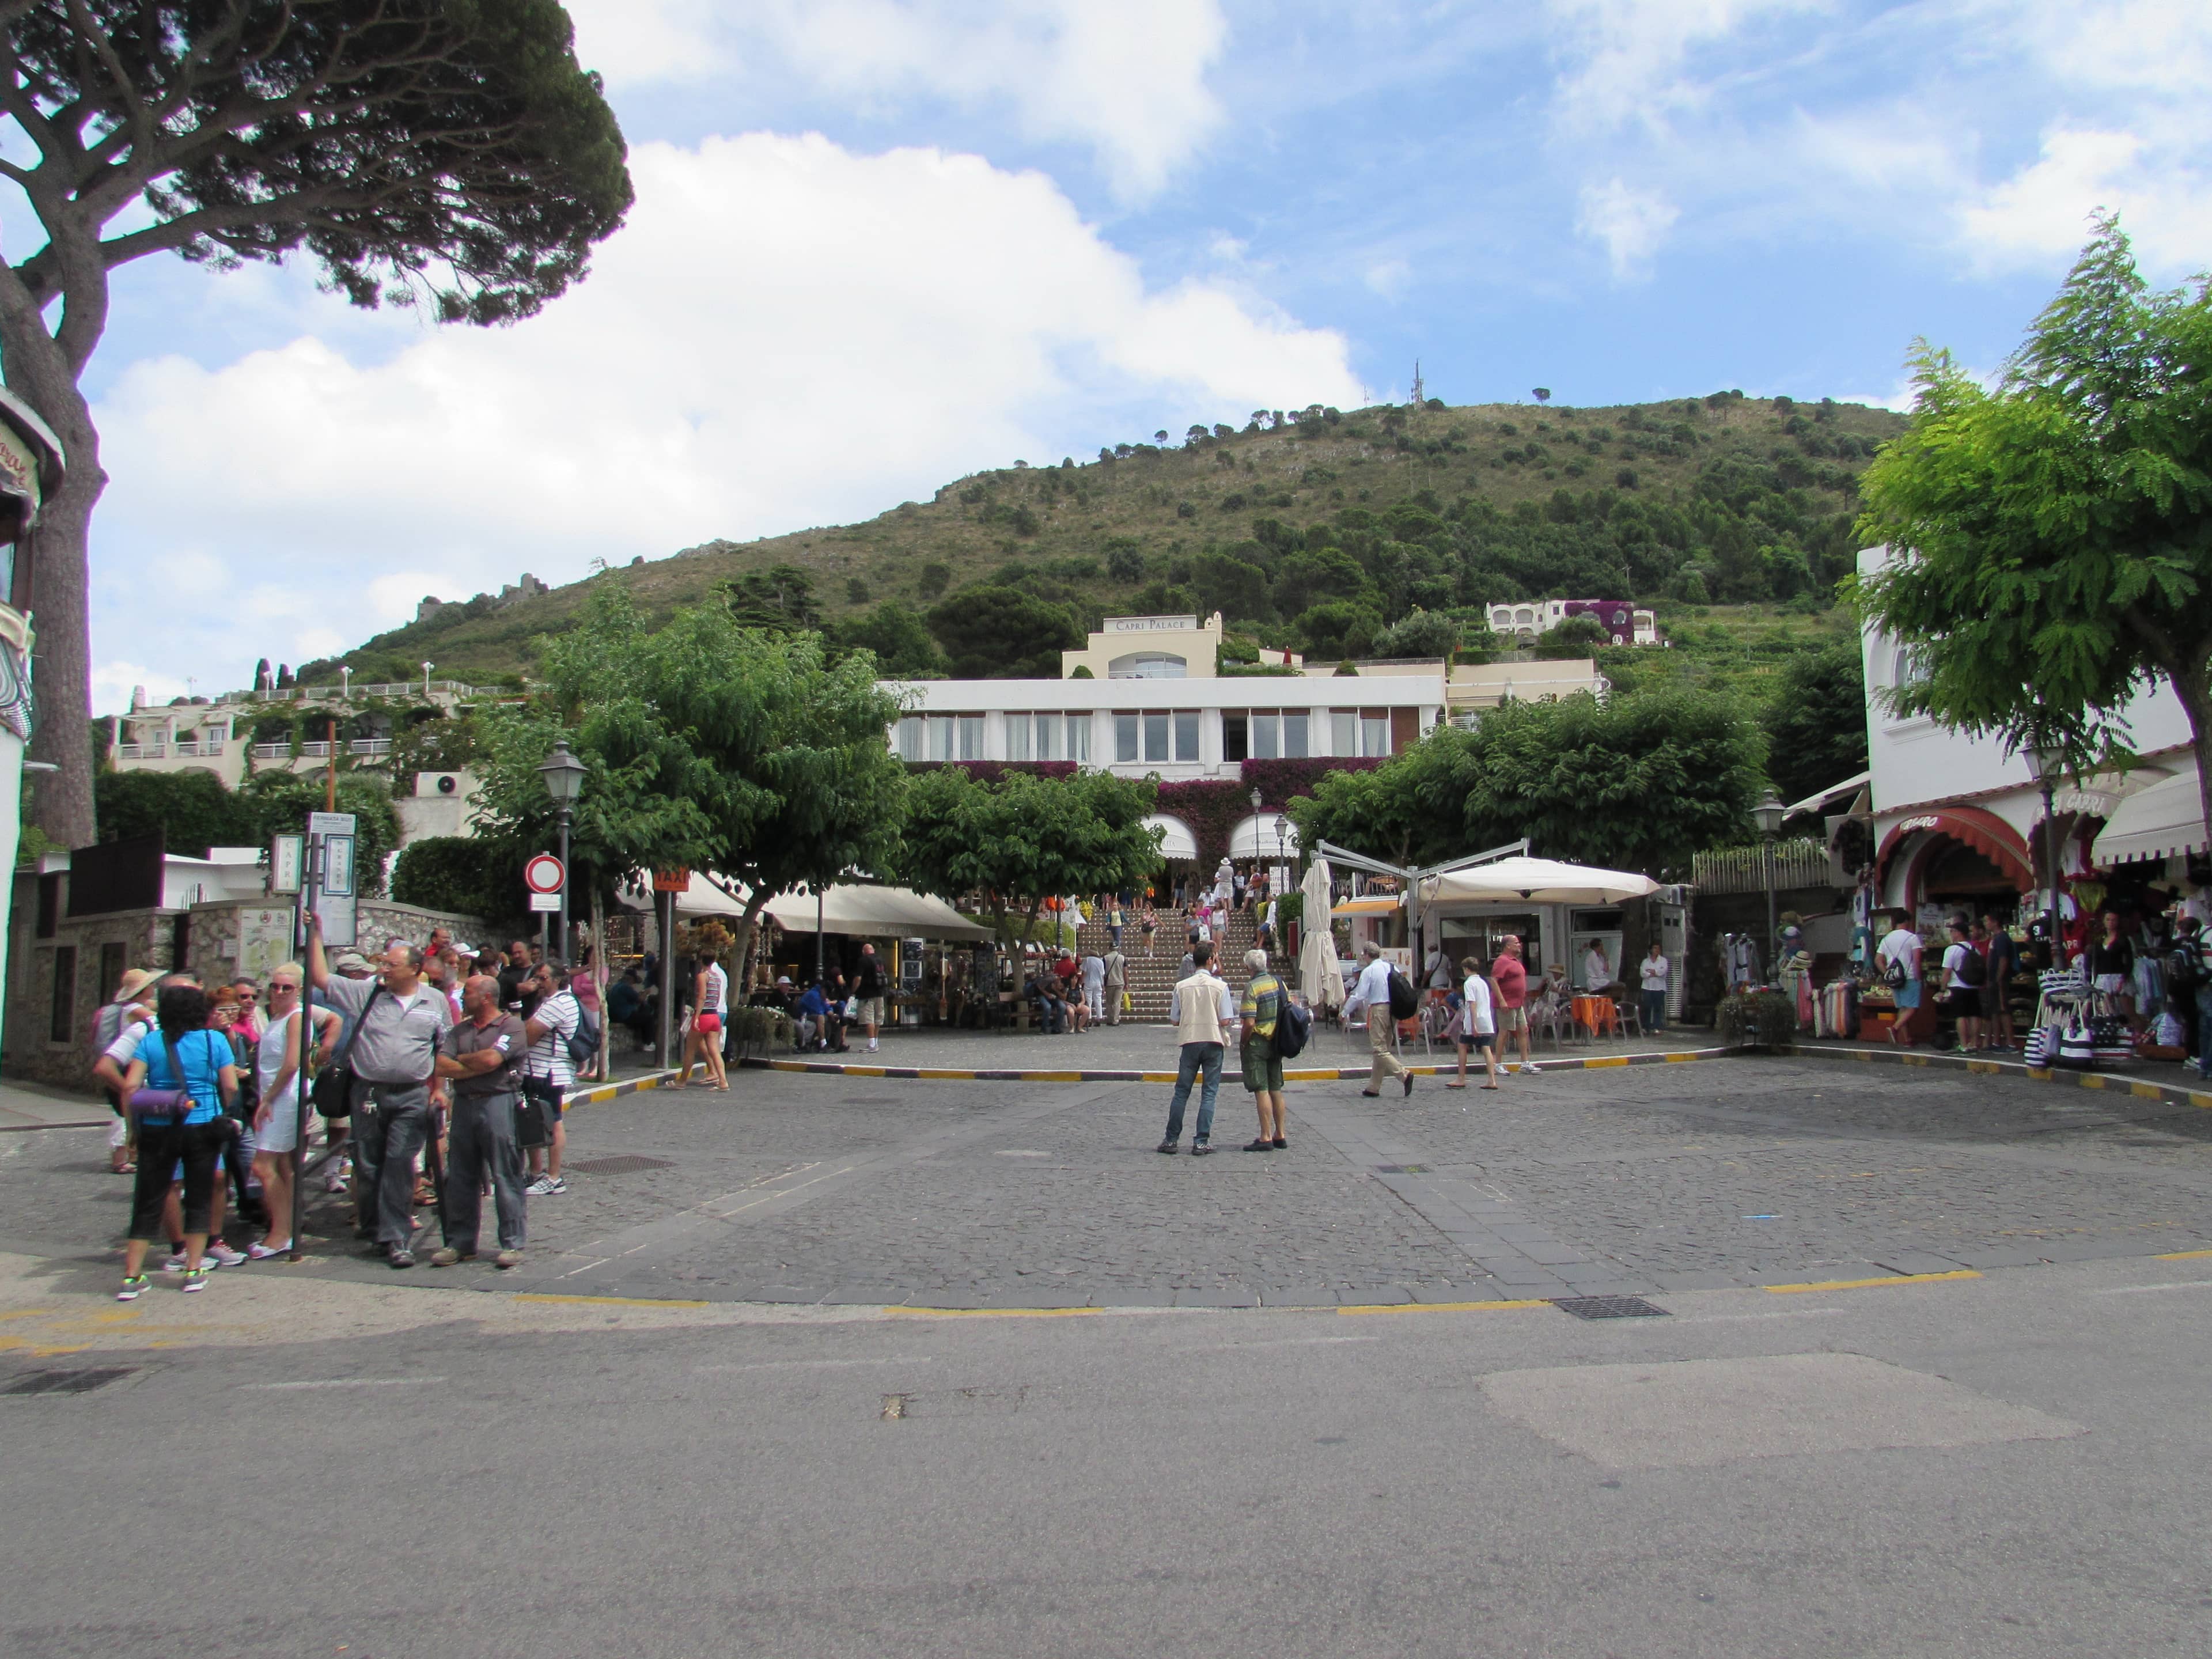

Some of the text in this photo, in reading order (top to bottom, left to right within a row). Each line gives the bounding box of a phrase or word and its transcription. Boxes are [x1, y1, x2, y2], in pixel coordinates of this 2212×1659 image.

[1116, 620, 1184, 631] CAPRI PALACE
[2067, 794, 2104, 812] CAPRI
